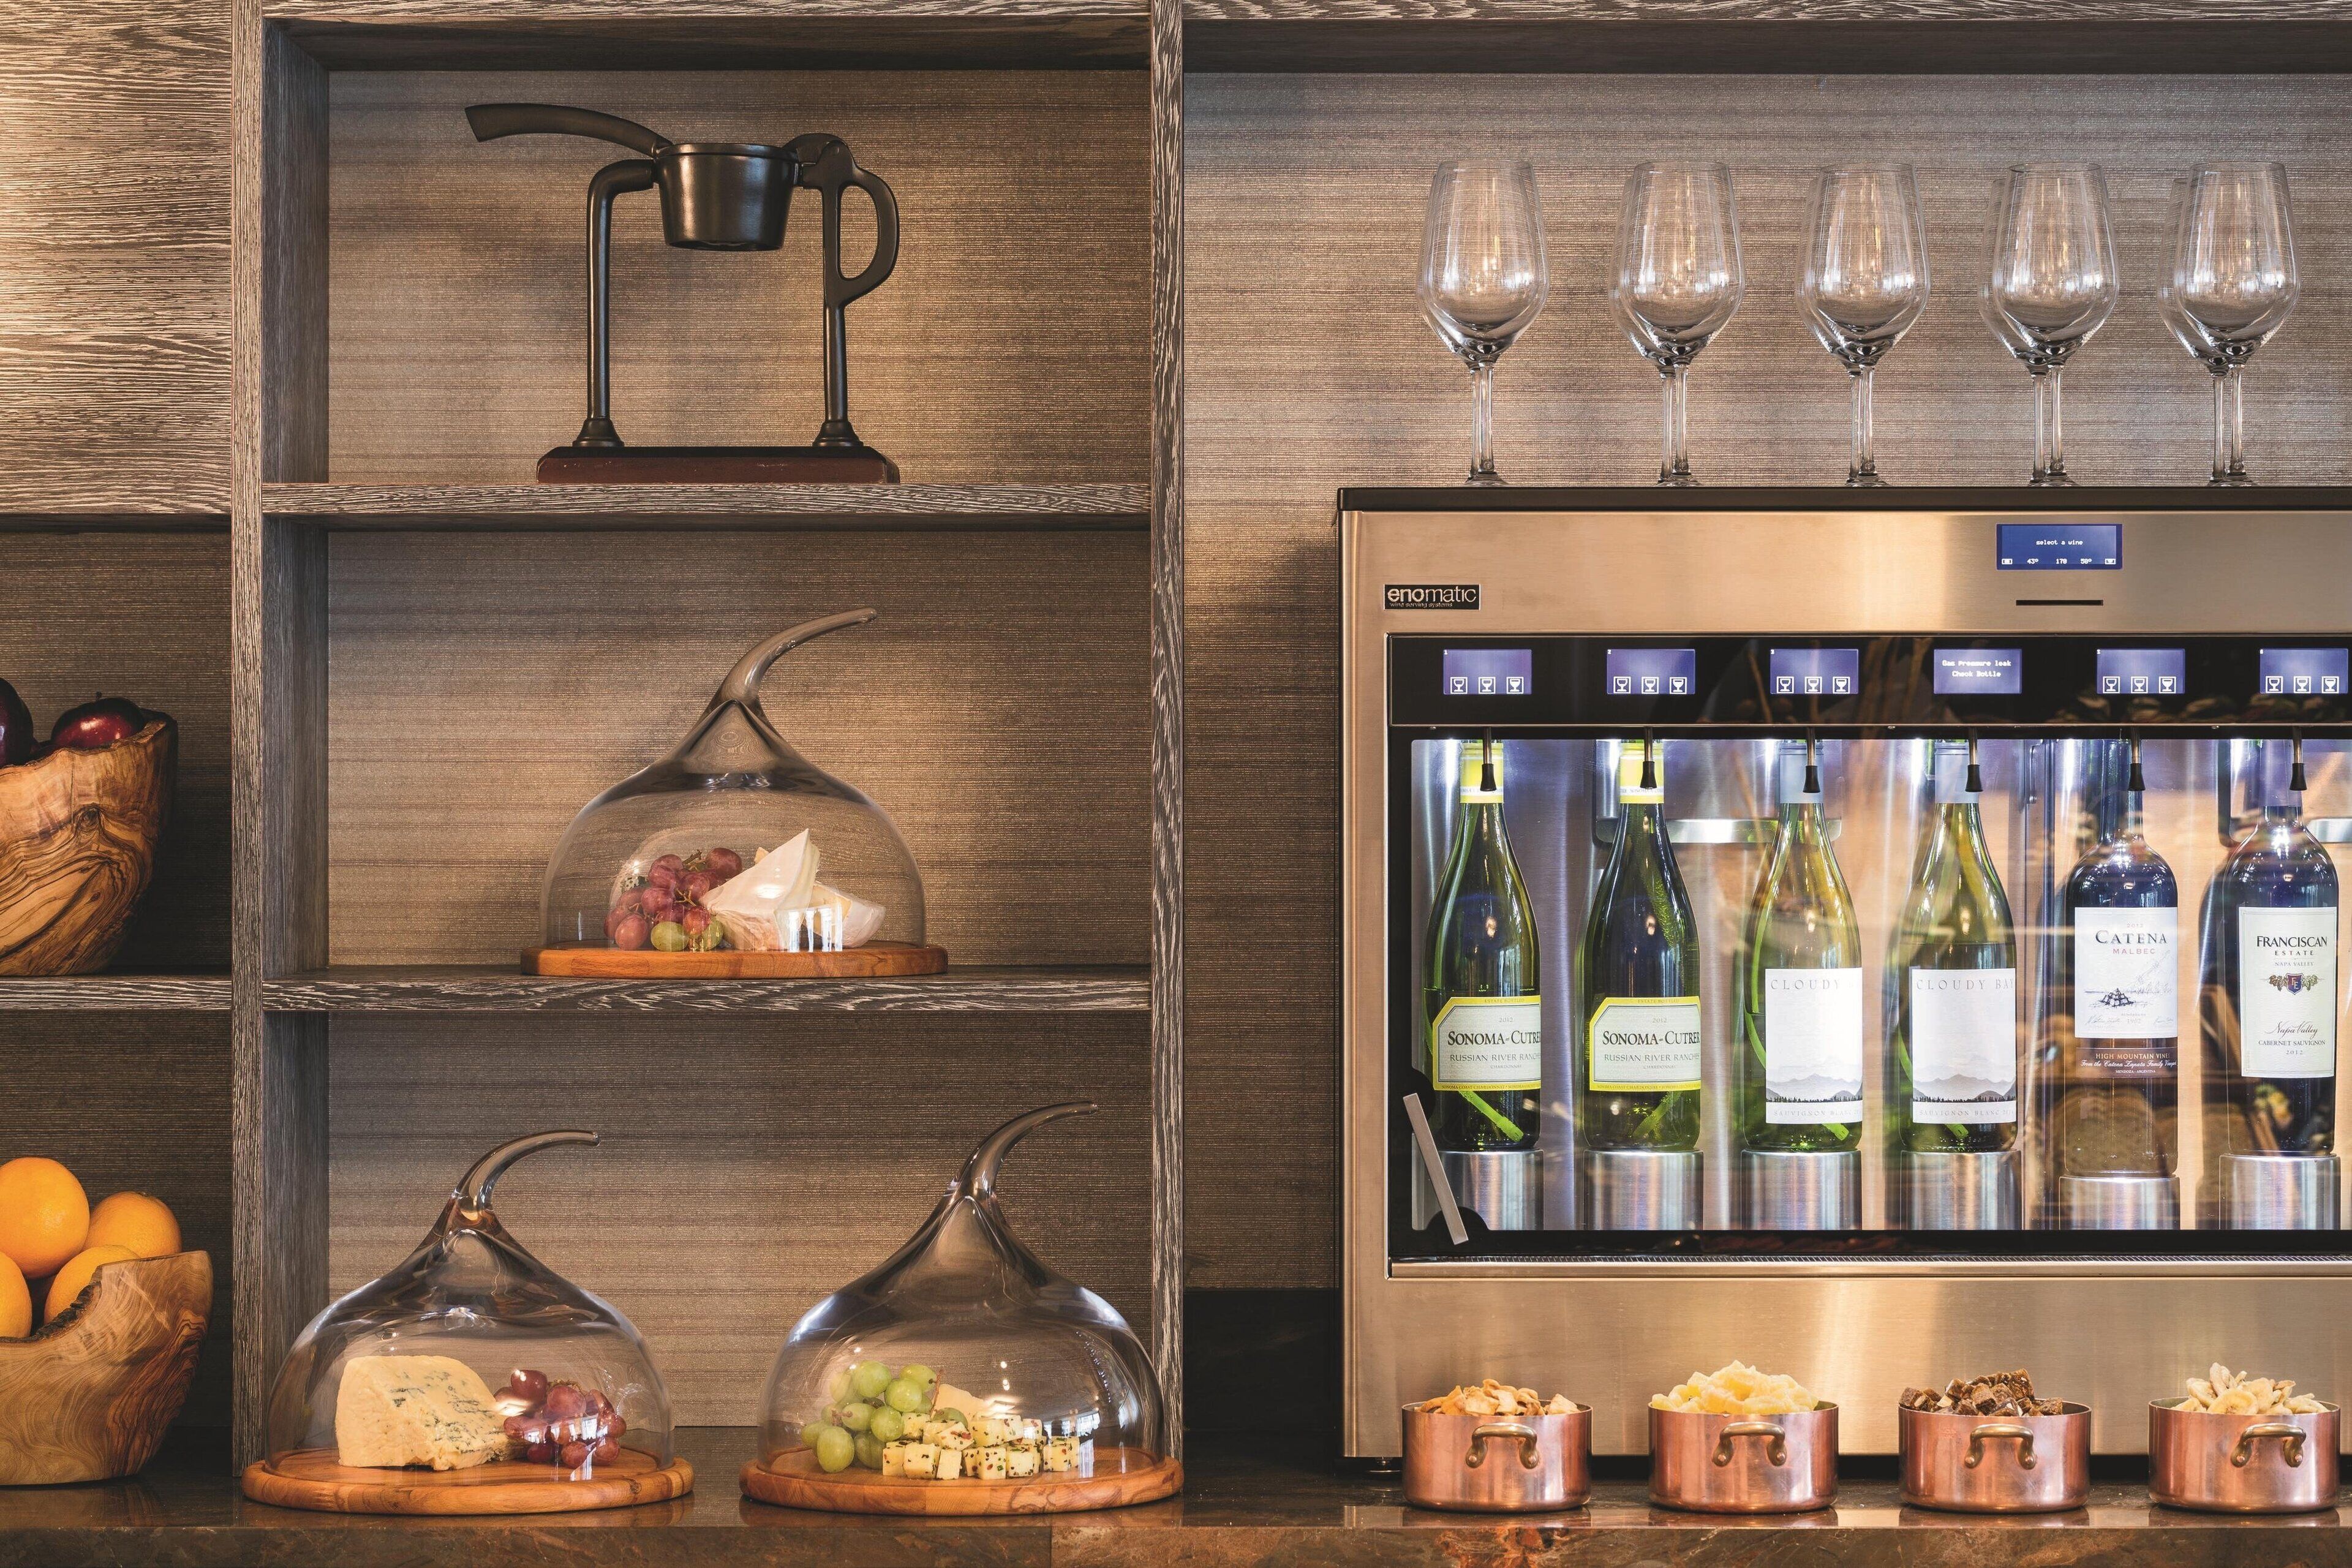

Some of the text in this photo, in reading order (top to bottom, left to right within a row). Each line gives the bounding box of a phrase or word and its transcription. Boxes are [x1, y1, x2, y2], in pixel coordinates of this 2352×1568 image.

[1387, 586, 1477, 602] enomatic
[1917, 979, 1985, 990] CLOUDY
[1447, 1030, 1541, 1046] SONOMA-CUTRE
[2264, 1020, 2318, 1040] Napa Valley
[2124, 1060, 2146, 1069] Zapata
